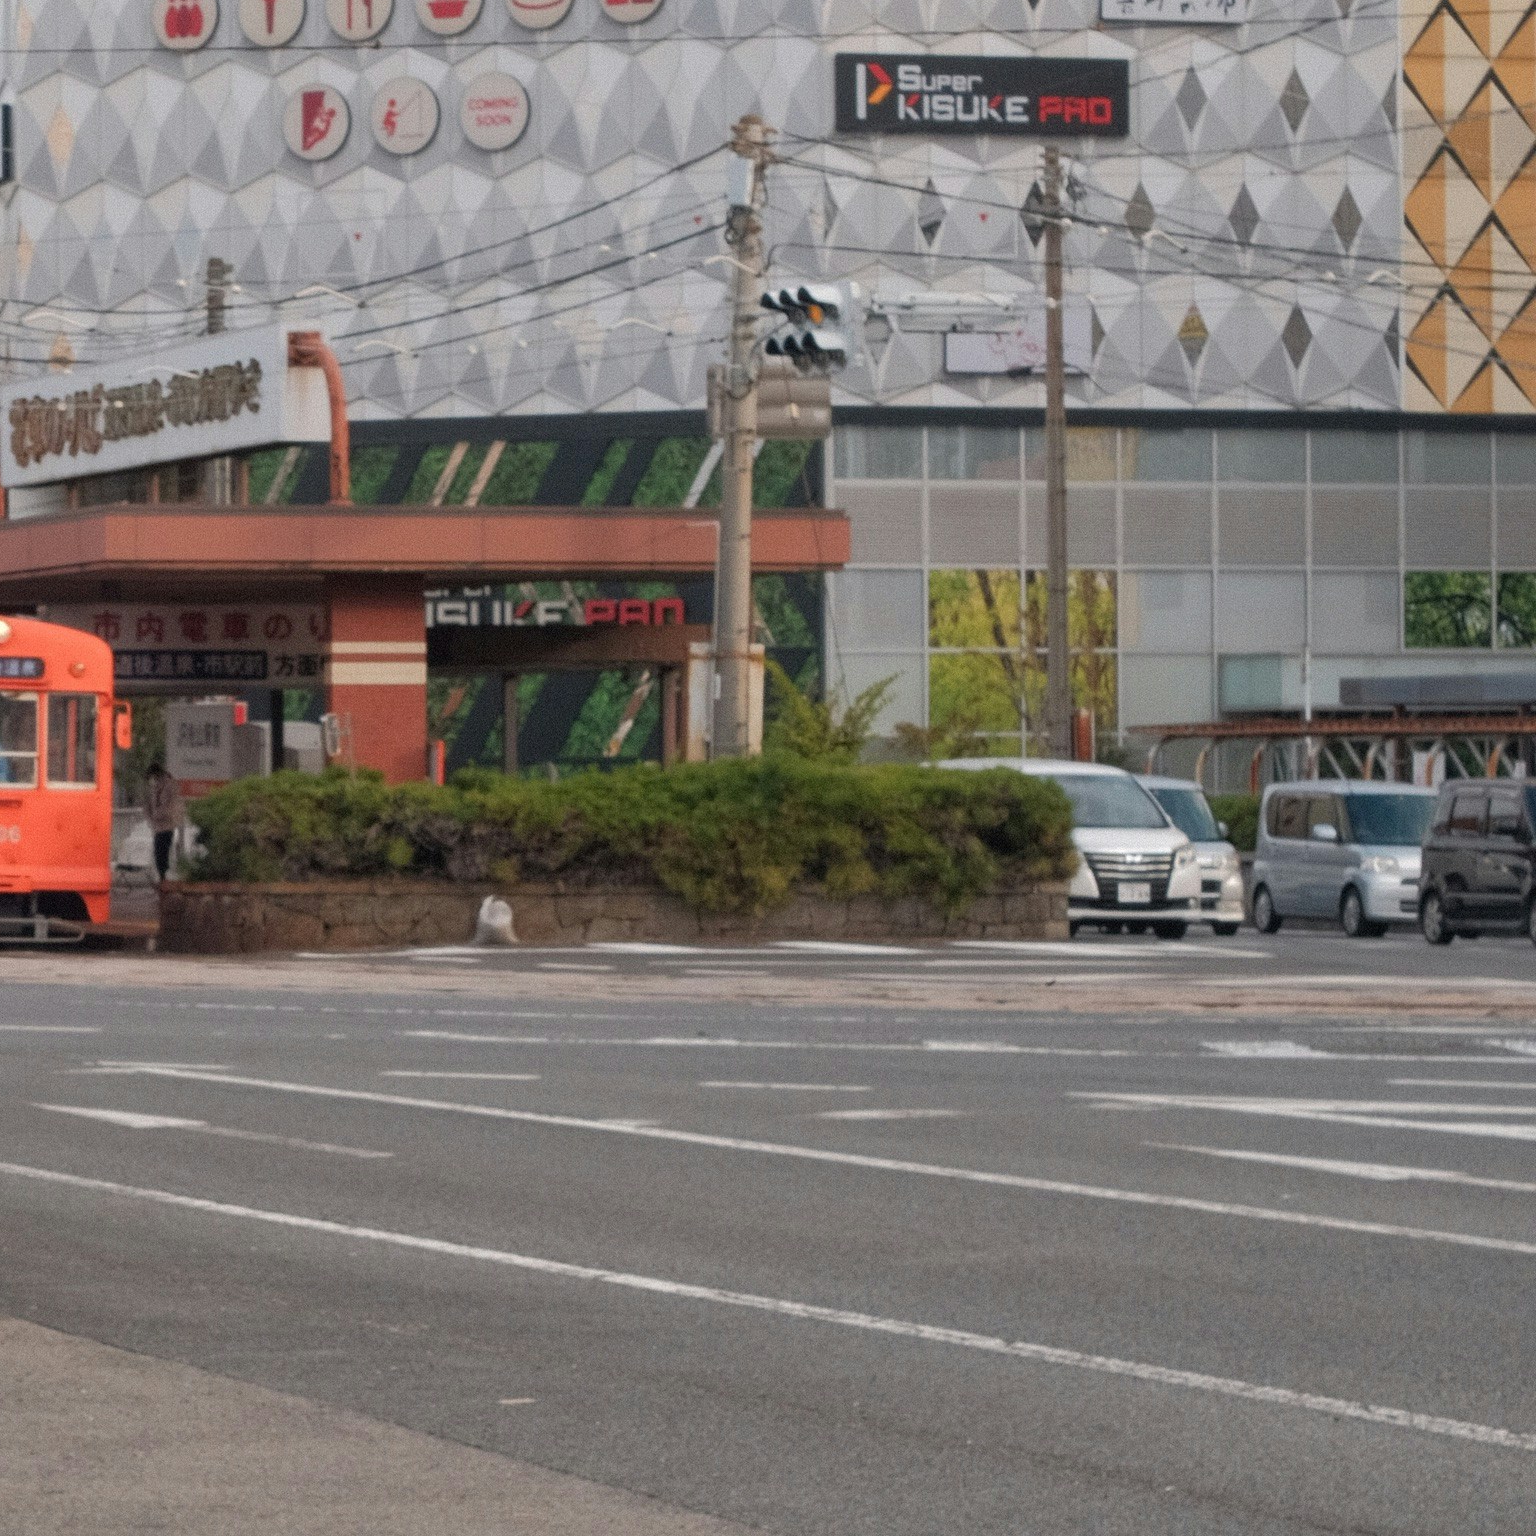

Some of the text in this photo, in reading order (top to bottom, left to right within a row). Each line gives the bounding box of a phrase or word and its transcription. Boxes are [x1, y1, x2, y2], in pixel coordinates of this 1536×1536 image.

[466, 95, 519, 111] COMING
[897, 93, 1114, 125] KISUKE PRO
[475, 114, 512, 127] SOON
[424, 599, 570, 628] ISUKE
